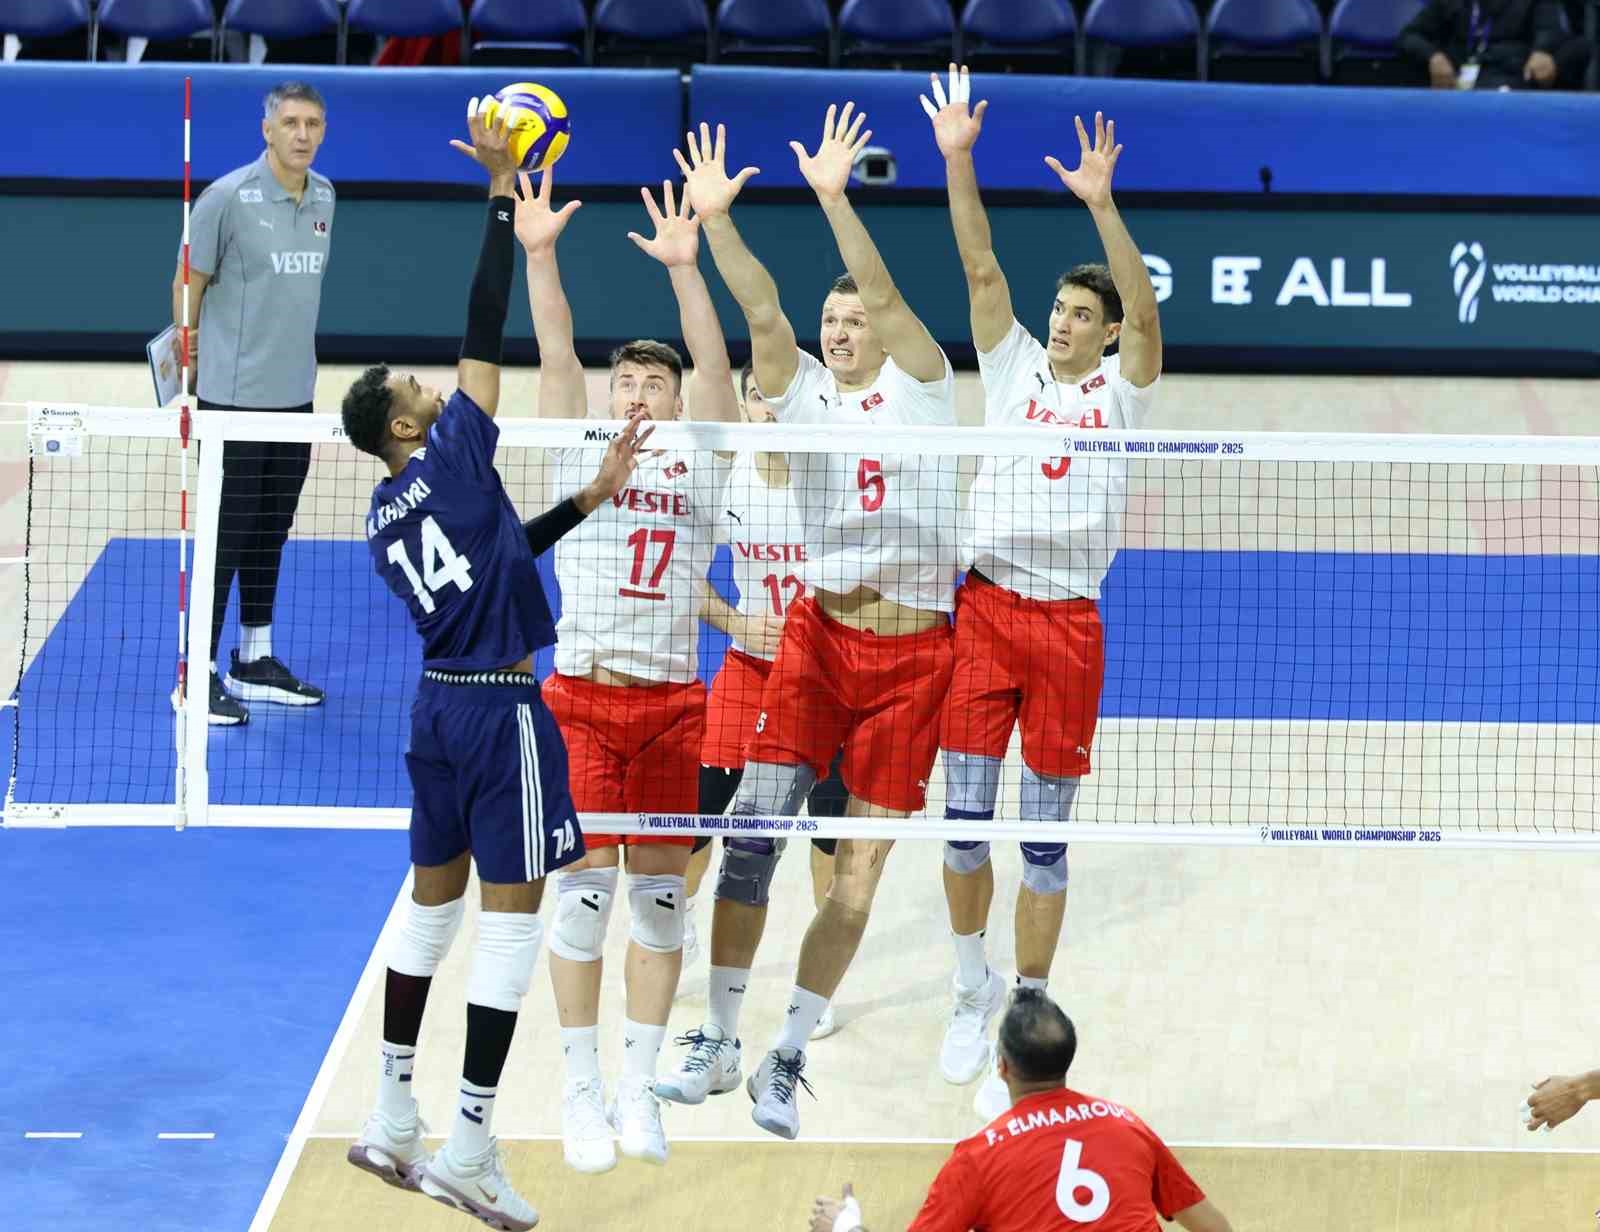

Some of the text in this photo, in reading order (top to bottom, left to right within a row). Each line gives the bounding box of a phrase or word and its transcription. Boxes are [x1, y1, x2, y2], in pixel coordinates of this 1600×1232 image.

[1275, 257, 1412, 307] ALL
[1492, 285, 1562, 302] WORLD
[1074, 440, 1244, 454] VOLLEYBALL WORLD CHAMPIONSHIP 2025
[857, 459, 886, 512] 5
[386, 515, 474, 614] 14
[627, 528, 676, 588] 17
[736, 541, 808, 562] VESTE
[762, 574, 806, 617] 12
[552, 819, 576, 859] 14
[649, 815, 818, 831] VOLLEYBALL WORLD CHAMPIONSHIP 2025
[1271, 829, 1441, 842] VOLLEYBALL WORLD CHAMPIONSHIP 2025
[1056, 1138, 1110, 1223] 6
